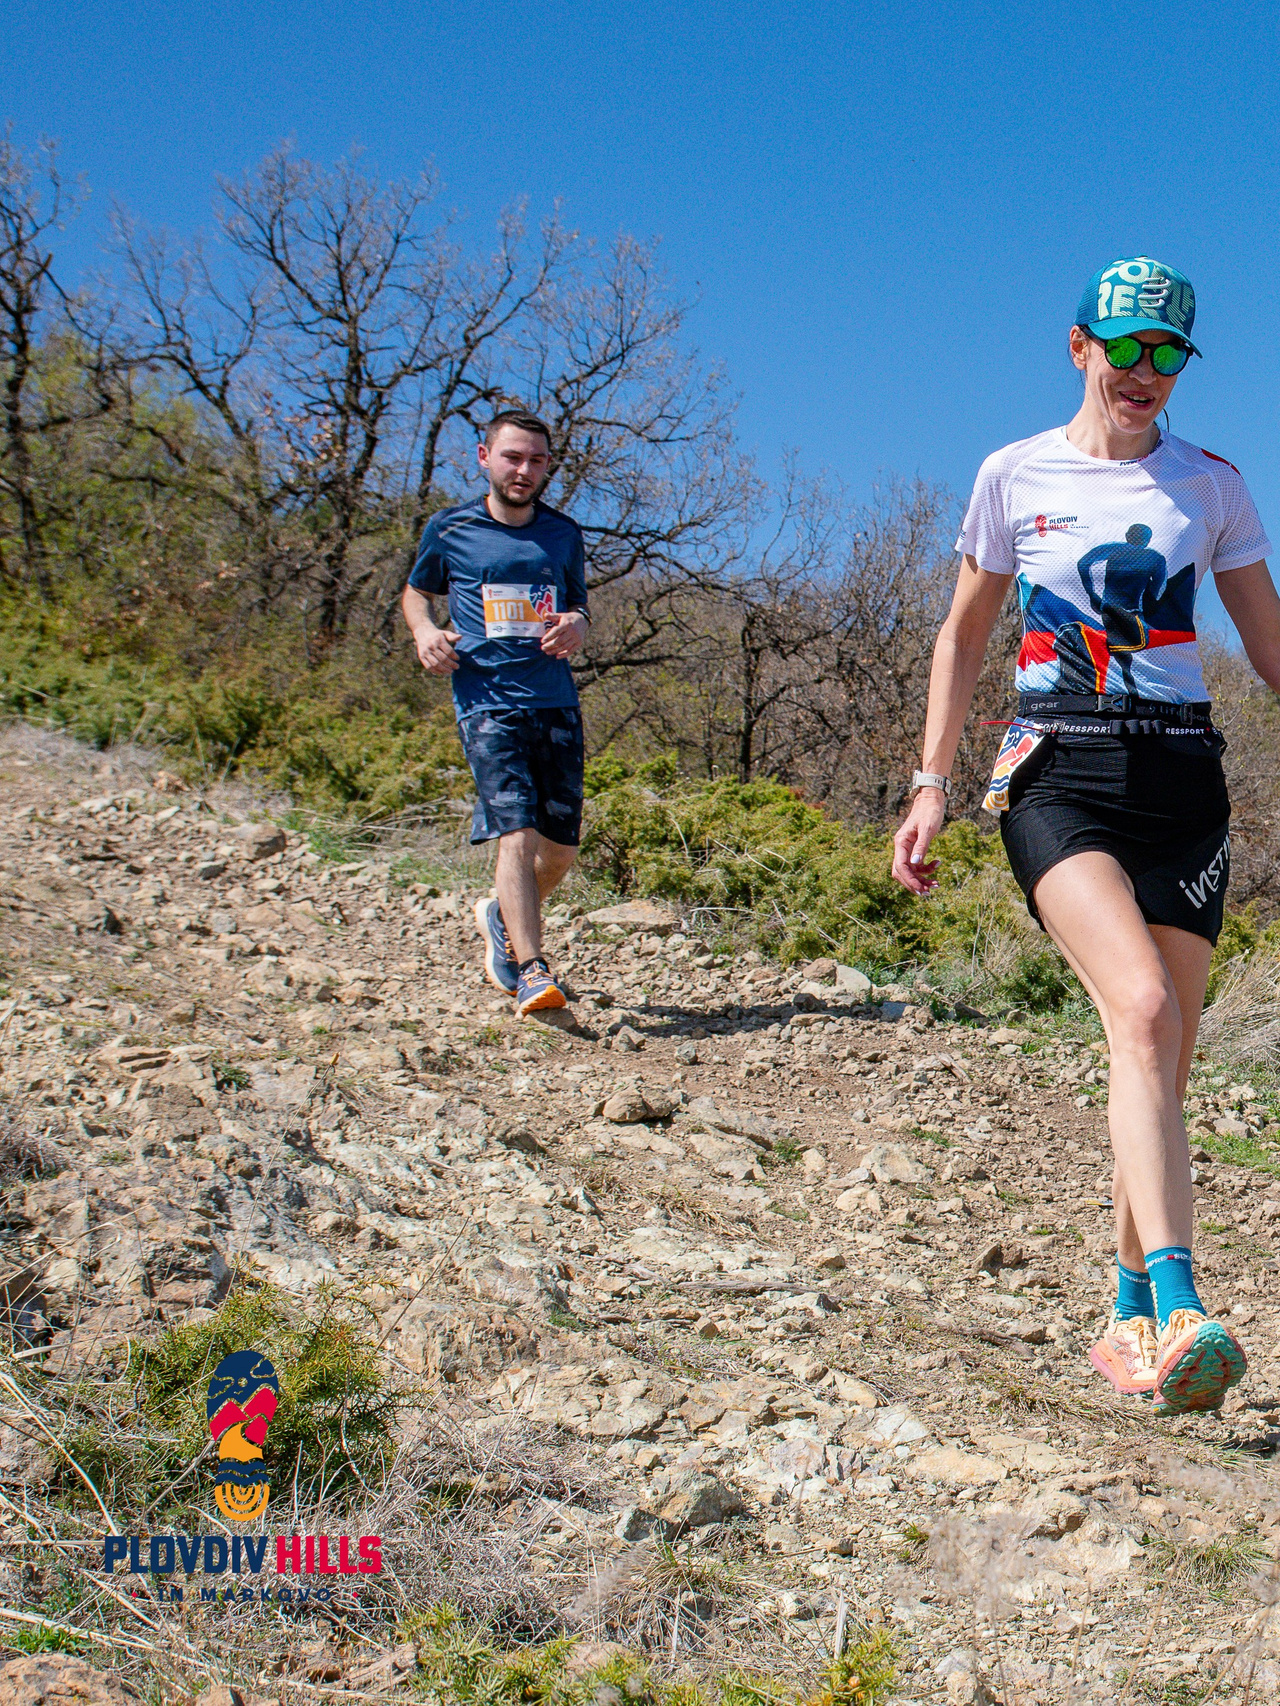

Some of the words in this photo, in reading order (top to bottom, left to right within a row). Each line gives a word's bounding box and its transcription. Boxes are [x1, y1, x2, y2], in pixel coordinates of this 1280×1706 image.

[1049, 516, 1077, 524] PLOVDIV
[492, 601, 524, 620] 1101
[1031, 701, 1059, 712] gear
